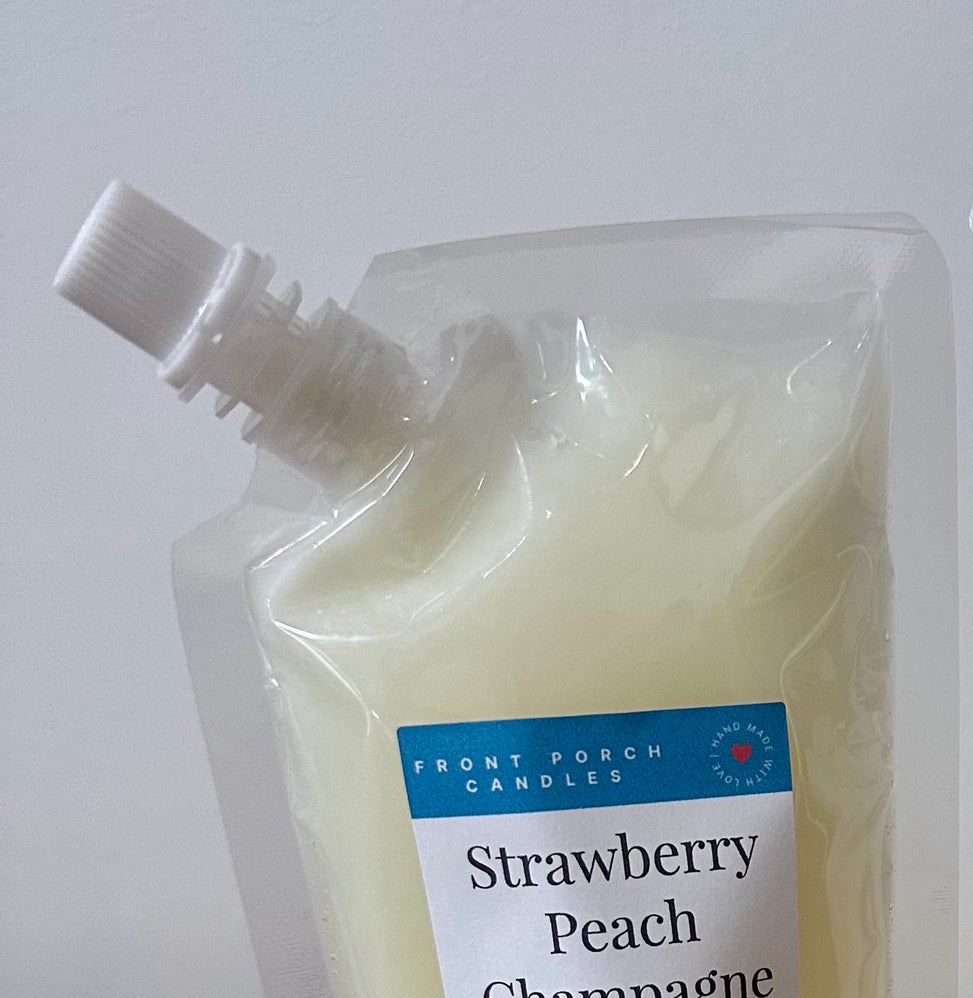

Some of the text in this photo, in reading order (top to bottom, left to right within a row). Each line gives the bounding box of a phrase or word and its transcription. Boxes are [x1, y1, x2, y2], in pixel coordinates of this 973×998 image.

[414, 744, 663, 775] FRONT PORCH
[466, 769, 623, 794] CANDLES
[711, 722, 774, 787] HAND MADE WITH LOVE
[466, 832, 759, 890] Strawberry
[545, 898, 701, 955] Peach
